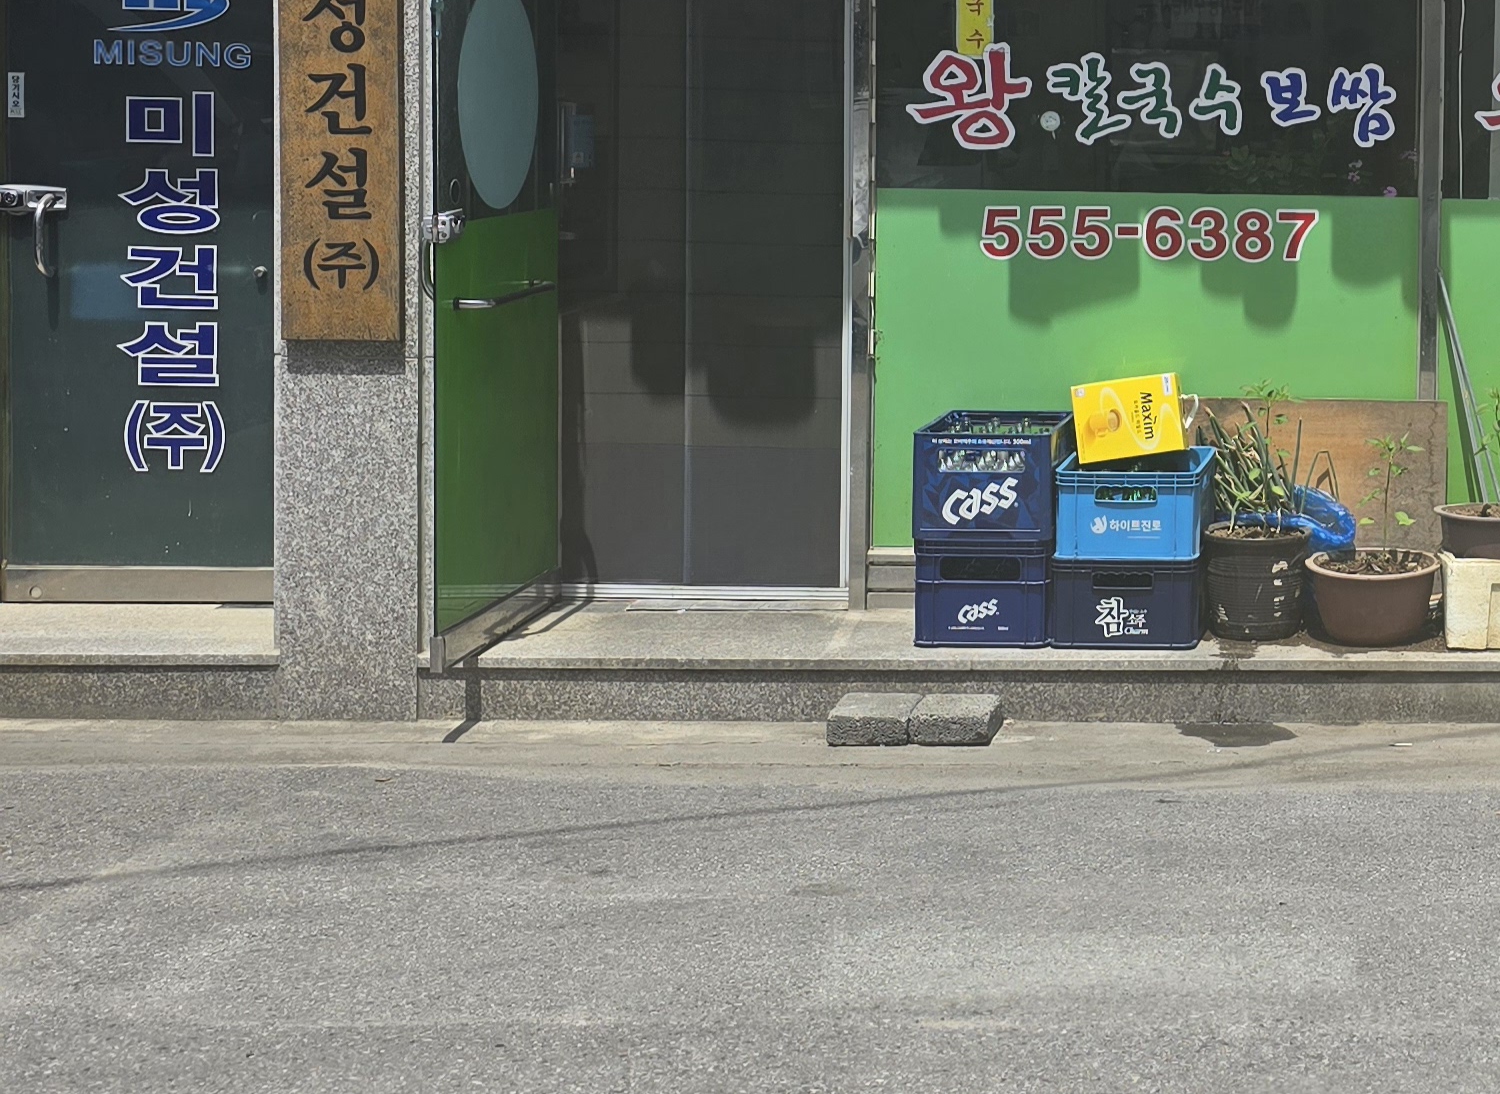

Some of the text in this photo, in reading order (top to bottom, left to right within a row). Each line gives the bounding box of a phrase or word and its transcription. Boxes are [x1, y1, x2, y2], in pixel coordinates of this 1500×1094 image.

[92, 38, 252, 69] MISUNG
[11, 75, 20, 108] 당기시오
[906, 42, 1396, 149] 왕 칼국수 보쌈
[979, 205, 1319, 262] 555-6387
[117, 90, 227, 472] 미성건설(주)
[1139, 391, 1157, 440] Maxim
[1109, 518, 1162, 532] 하이트진로
[1094, 596, 1129, 638] 참
[1126, 613, 1147, 628] 소주
